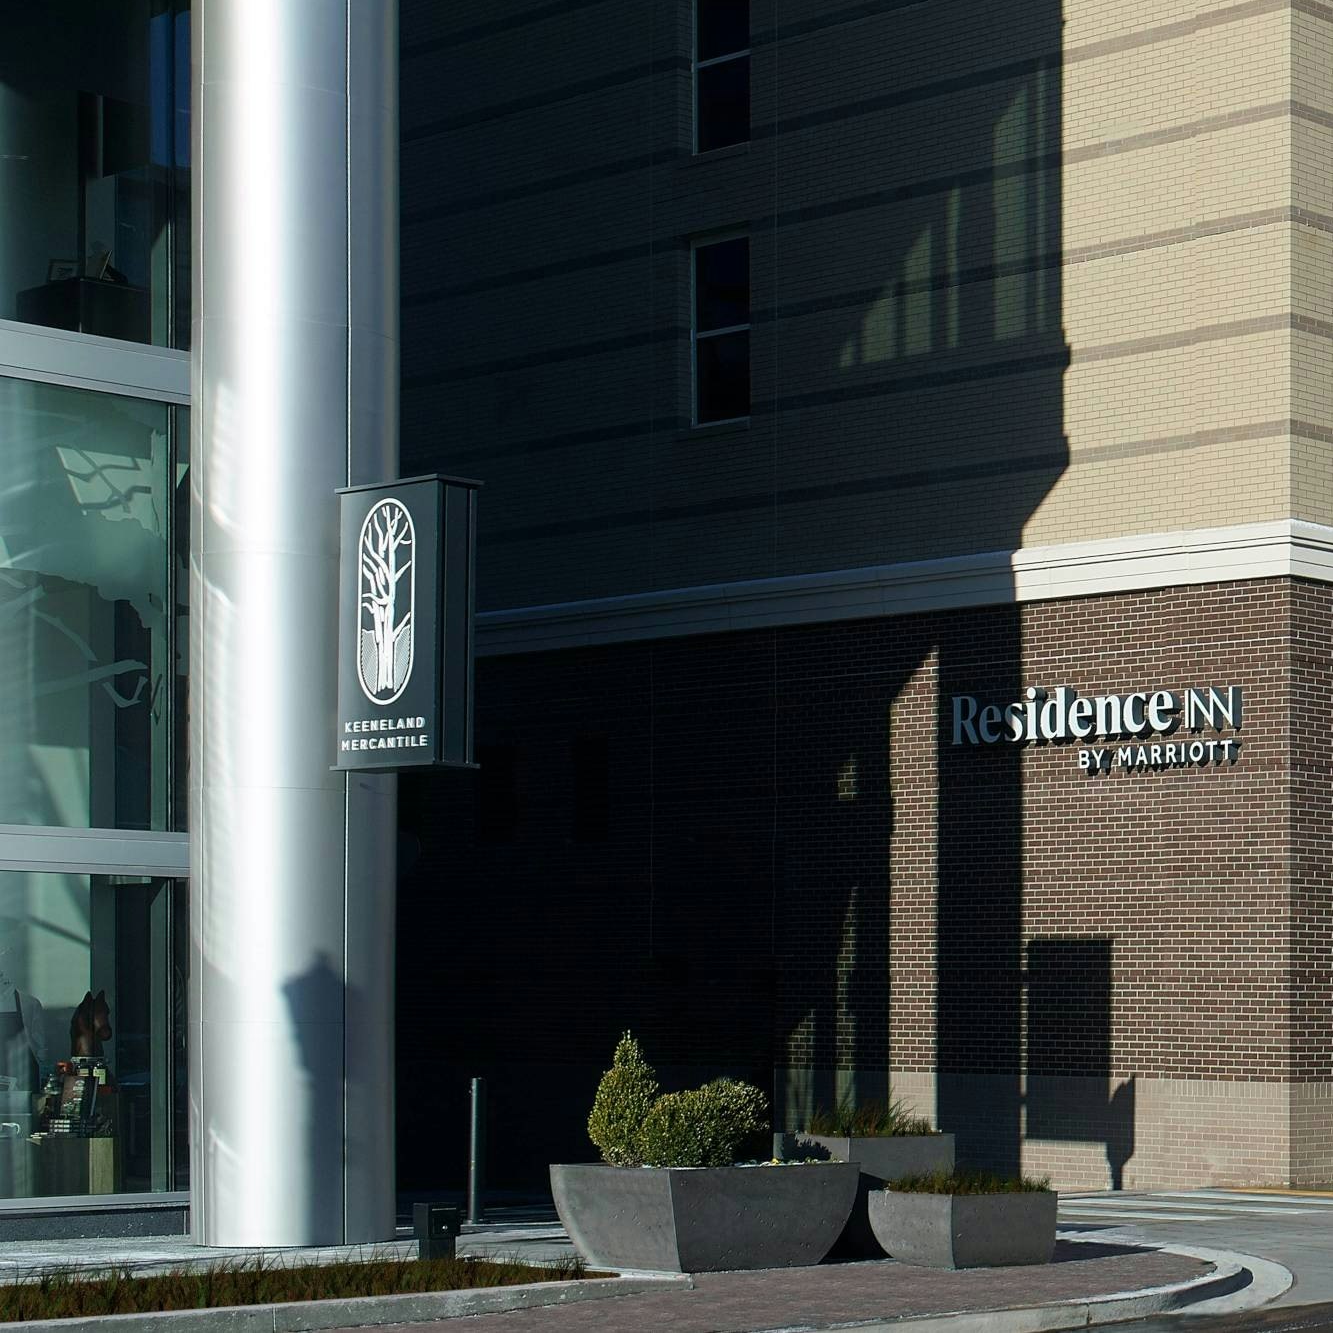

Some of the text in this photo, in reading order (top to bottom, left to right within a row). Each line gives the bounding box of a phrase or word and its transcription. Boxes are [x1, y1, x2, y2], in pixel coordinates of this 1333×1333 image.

[344, 716, 426, 733] KEENELAND
[951, 686, 1236, 745] Residence INN
[341, 734, 428, 751] MERCANTILE
[1078, 739, 1233, 769] BY MARRIOTT
